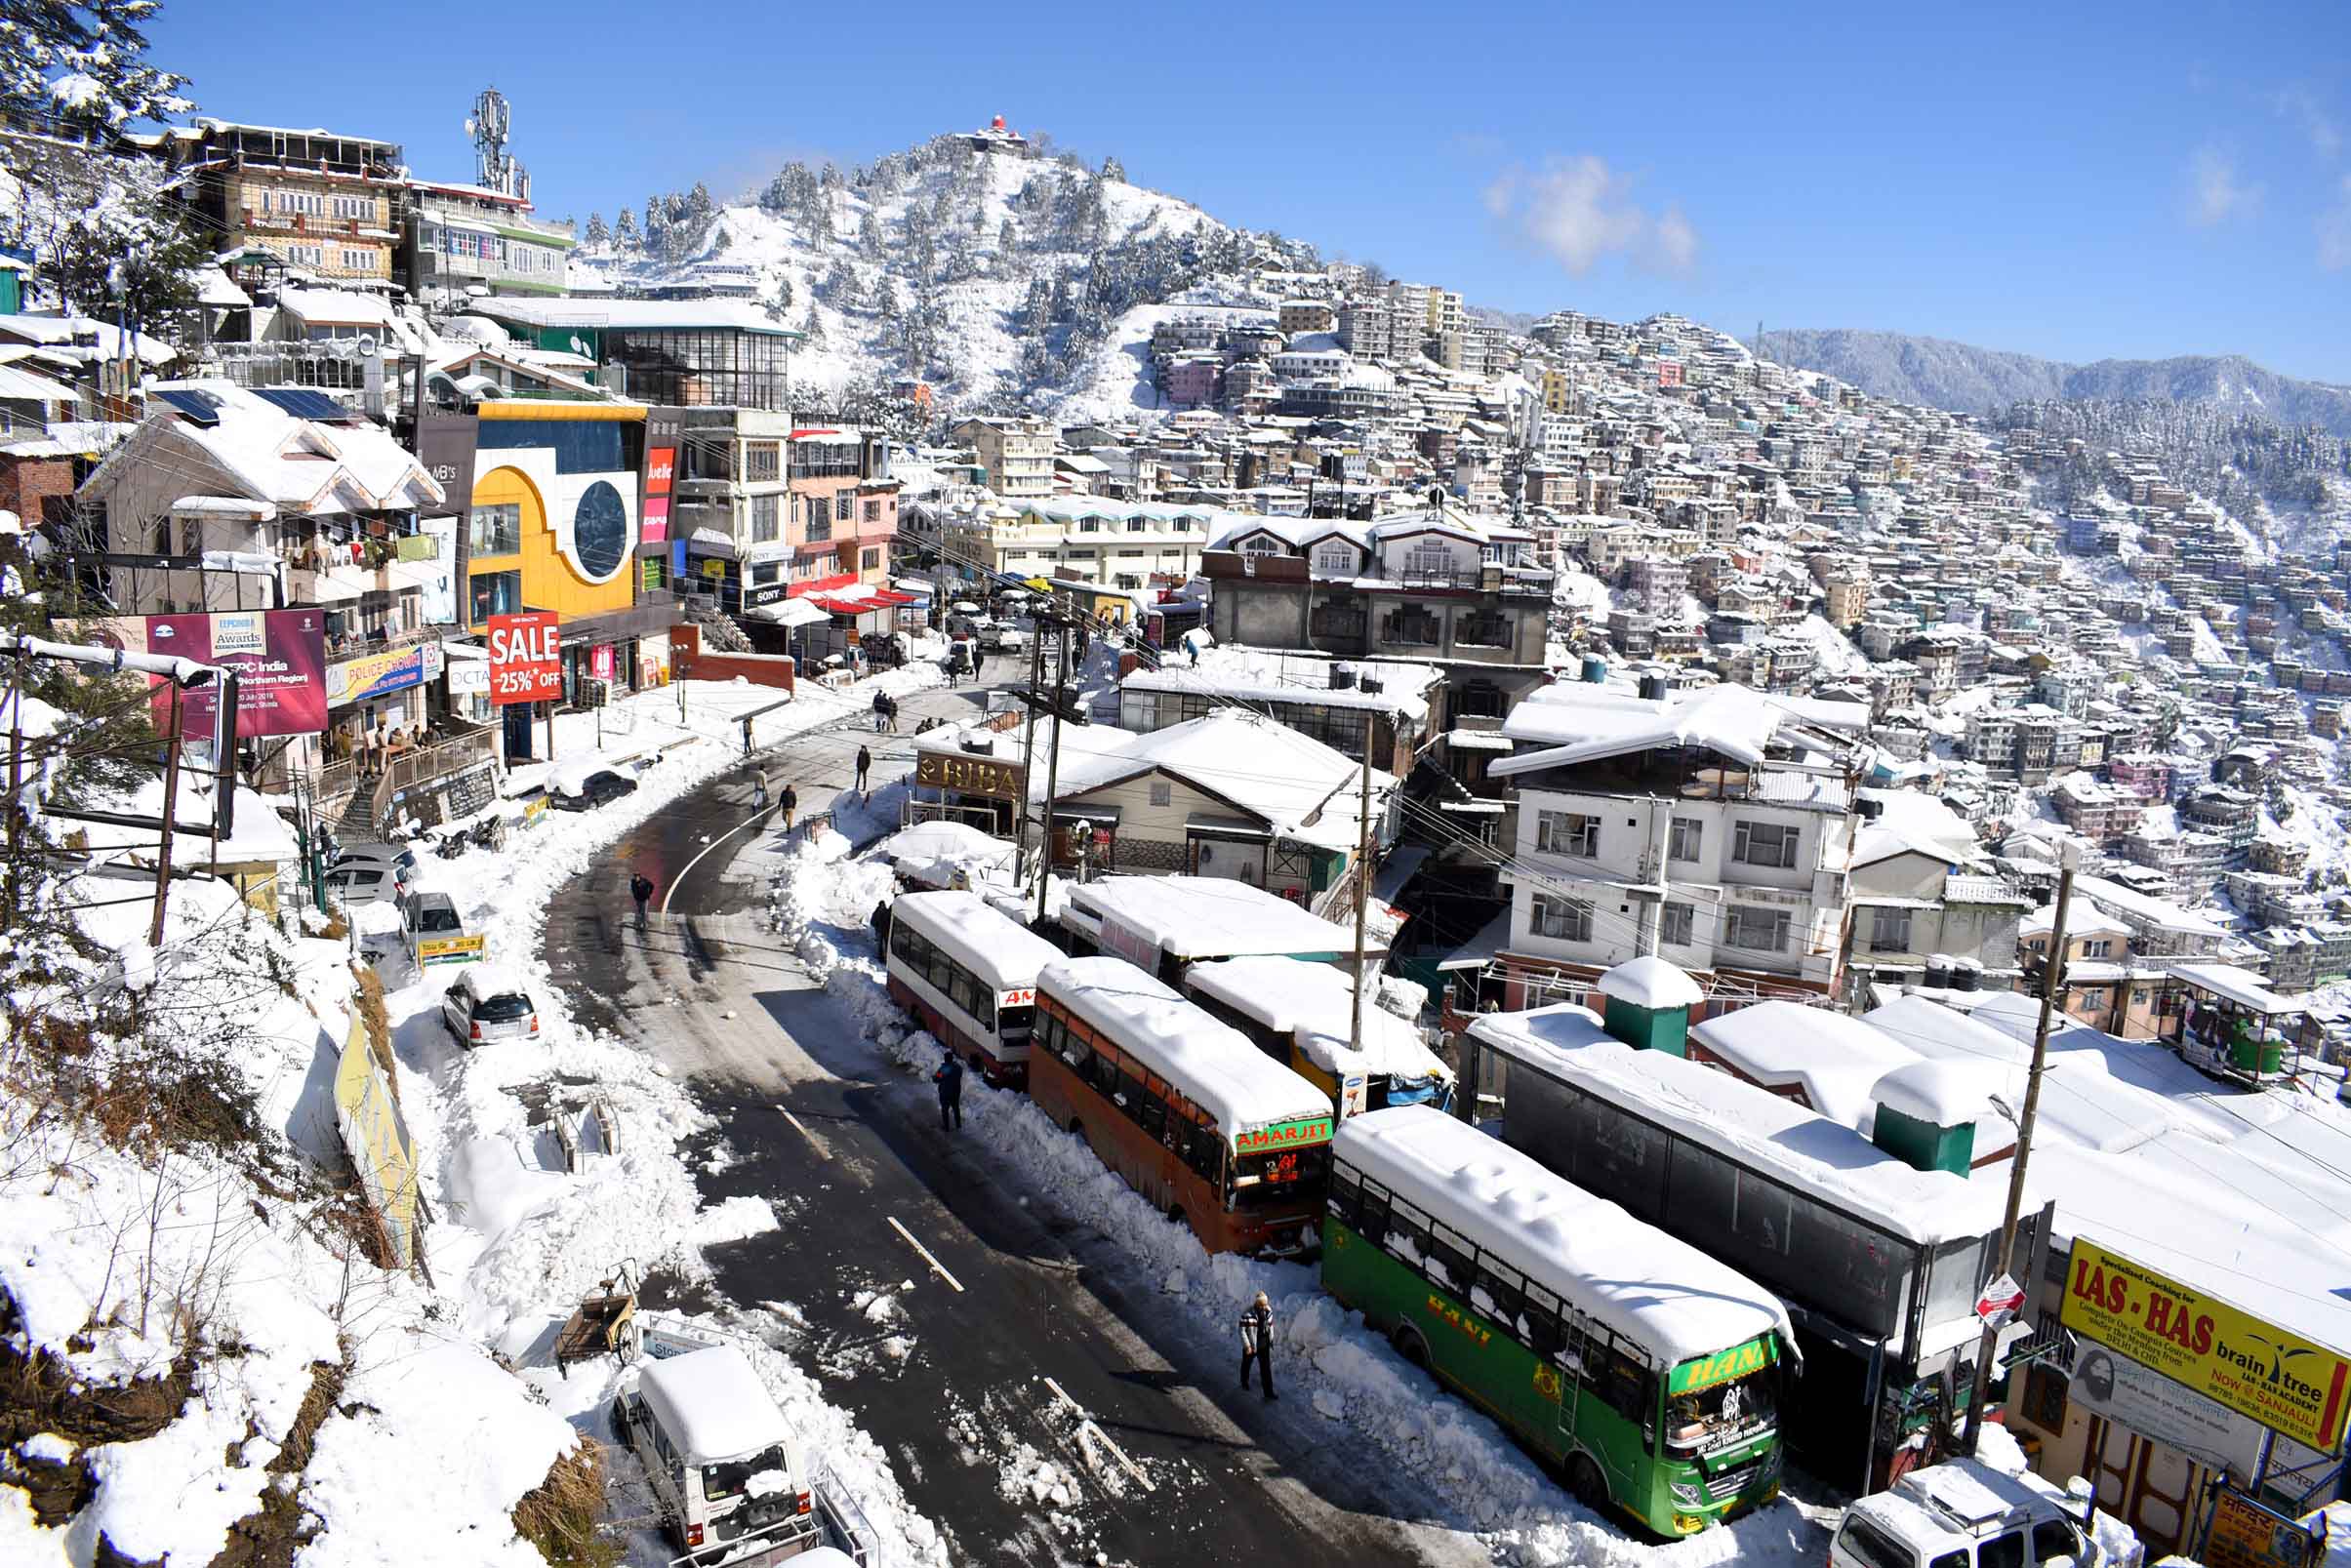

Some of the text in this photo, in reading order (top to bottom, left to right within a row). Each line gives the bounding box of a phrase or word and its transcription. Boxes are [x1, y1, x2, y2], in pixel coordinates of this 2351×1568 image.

[757, 589, 781, 602] SONY
[217, 632, 262, 643] Awards
[491, 625, 559, 664] SALE
[259, 661, 288, 672] India
[348, 662, 384, 681] POLICE
[596, 651, 610, 672] 40
[539, 671, 561, 688] OFF
[942, 758, 1017, 797] BIBA
[1237, 1123, 1328, 1146] AMARJIT
[2073, 1259, 2128, 1314] IAS
[2144, 1292, 2214, 1355] HAS
[1427, 1293, 1492, 1345] HANI
[2216, 1341, 2323, 1403] brain tree
